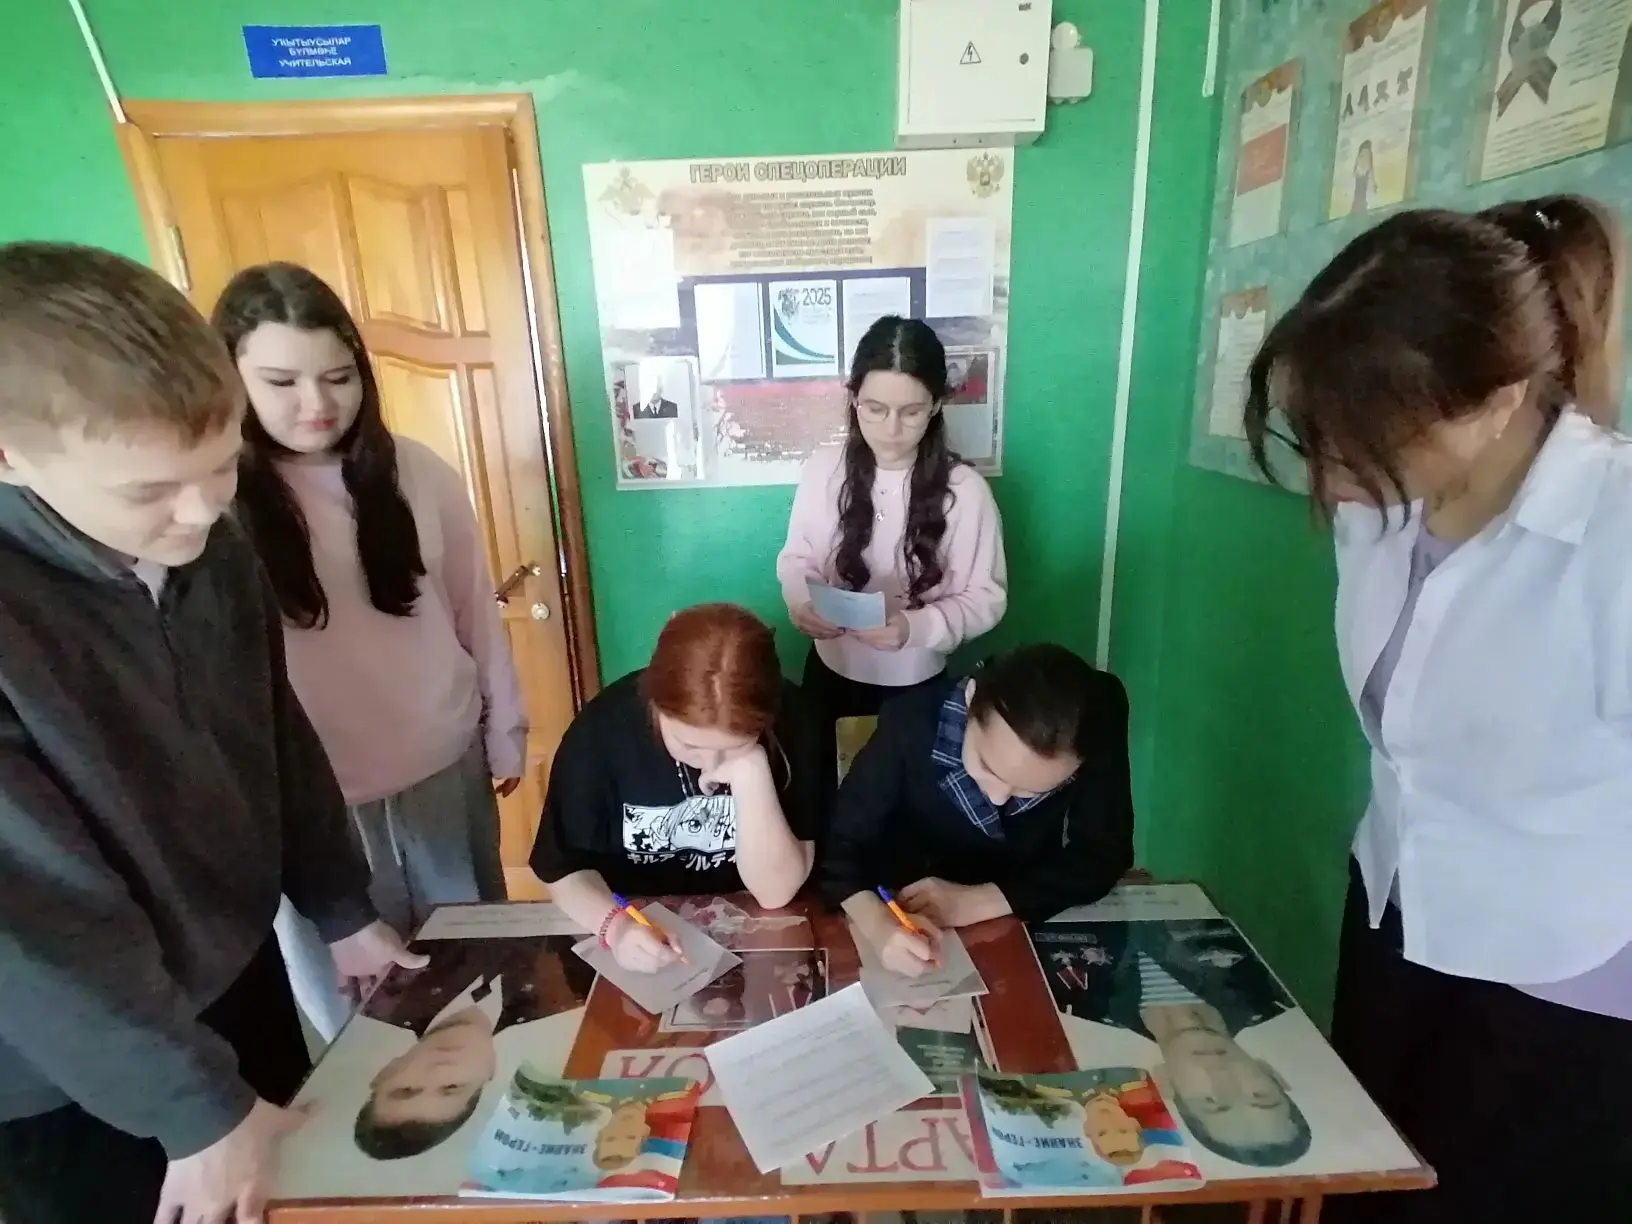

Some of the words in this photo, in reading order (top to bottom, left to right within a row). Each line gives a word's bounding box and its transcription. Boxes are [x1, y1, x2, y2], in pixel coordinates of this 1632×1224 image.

[279, 57, 351, 68] УЧИТЕЛЬСКАЯ
[690, 163, 750, 183] ГЕРОИ
[754, 157, 907, 182] СПЕЦОПЕРАЦИИ
[802, 287, 832, 306] 2025
